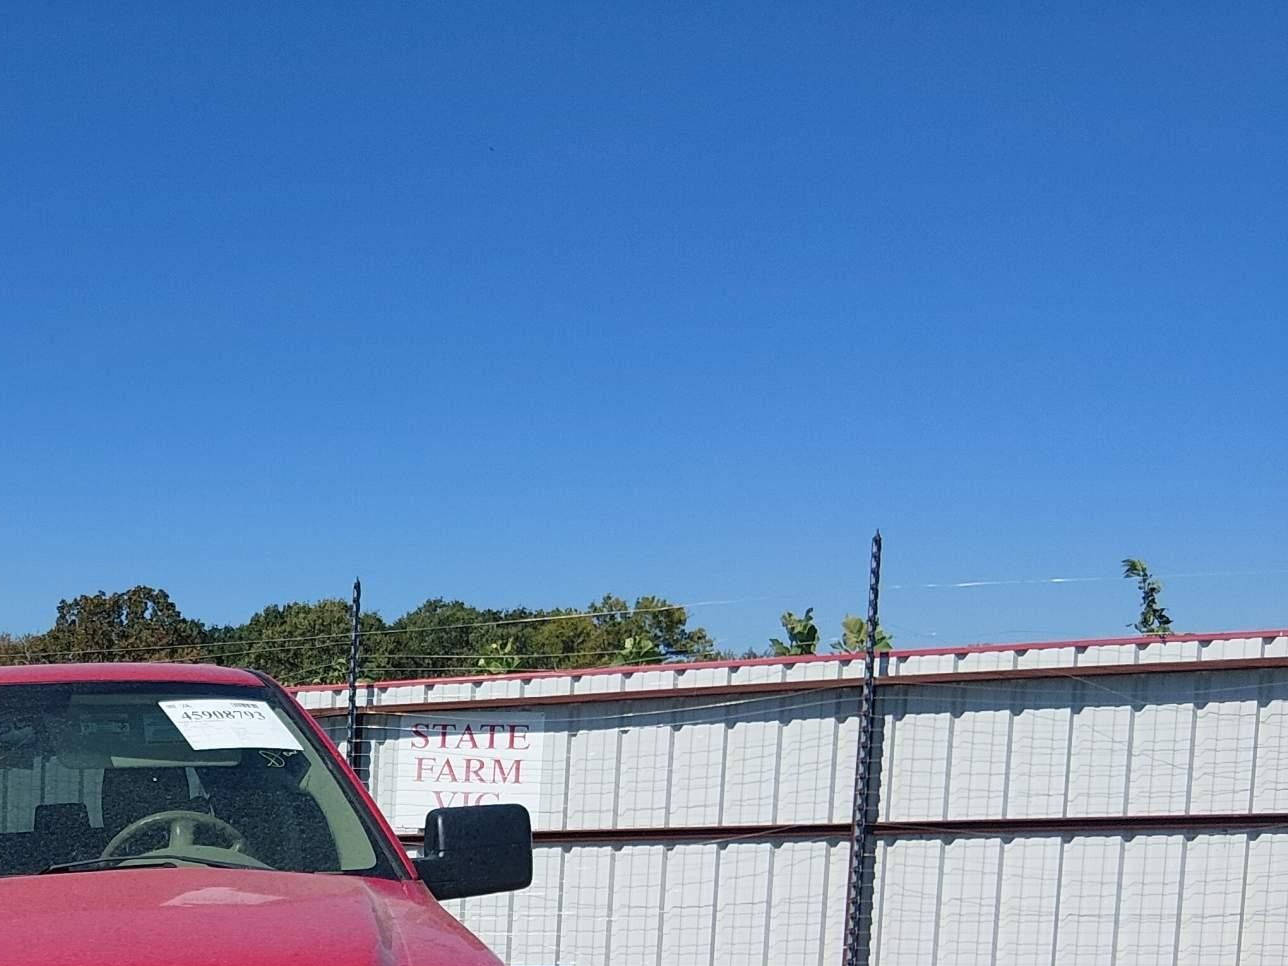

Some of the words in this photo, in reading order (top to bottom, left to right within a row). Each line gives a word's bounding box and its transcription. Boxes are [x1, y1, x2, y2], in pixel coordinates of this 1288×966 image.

[181, 709, 266, 721] 45908793
[410, 723, 530, 750] STATE
[414, 756, 522, 784] FARM
